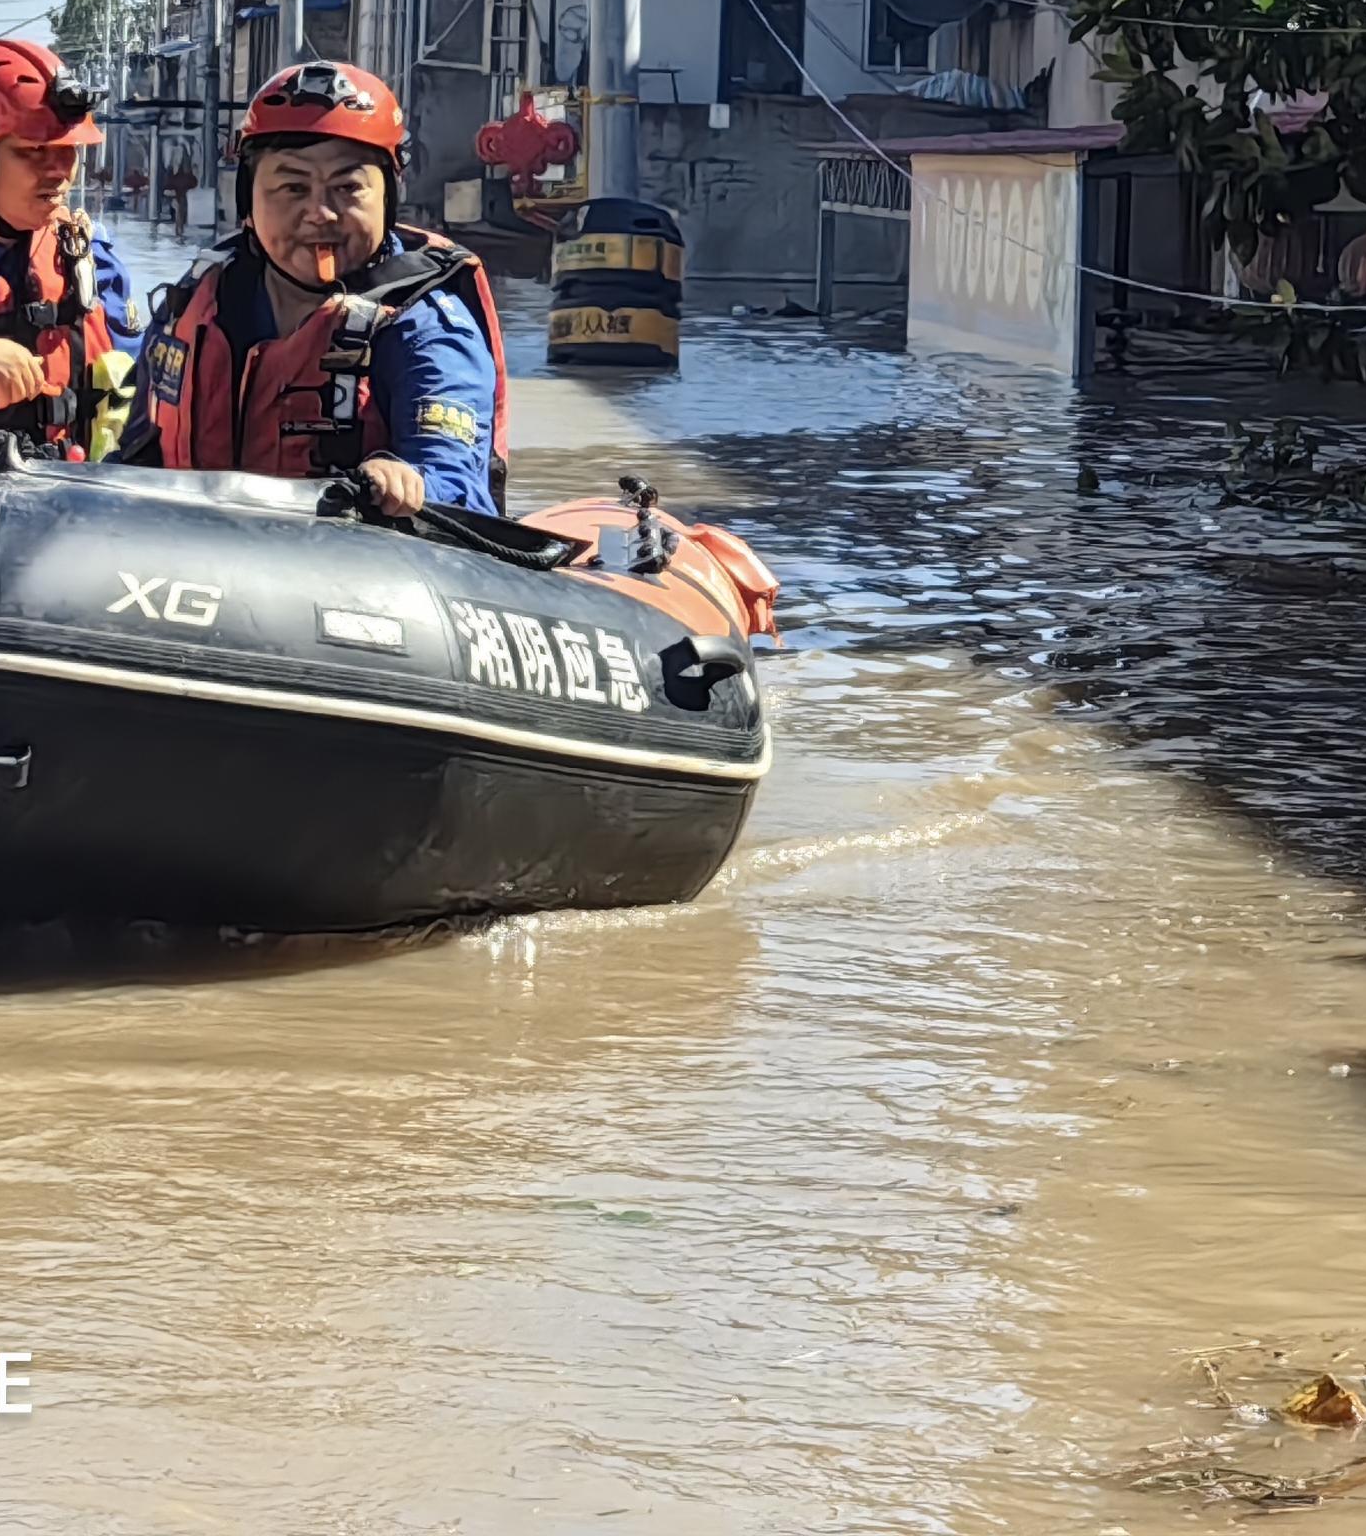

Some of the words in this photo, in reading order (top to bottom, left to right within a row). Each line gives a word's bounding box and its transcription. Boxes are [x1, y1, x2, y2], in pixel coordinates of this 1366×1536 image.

[106, 571, 223, 626] XG
[451, 600, 651, 713] 湘阴应急
